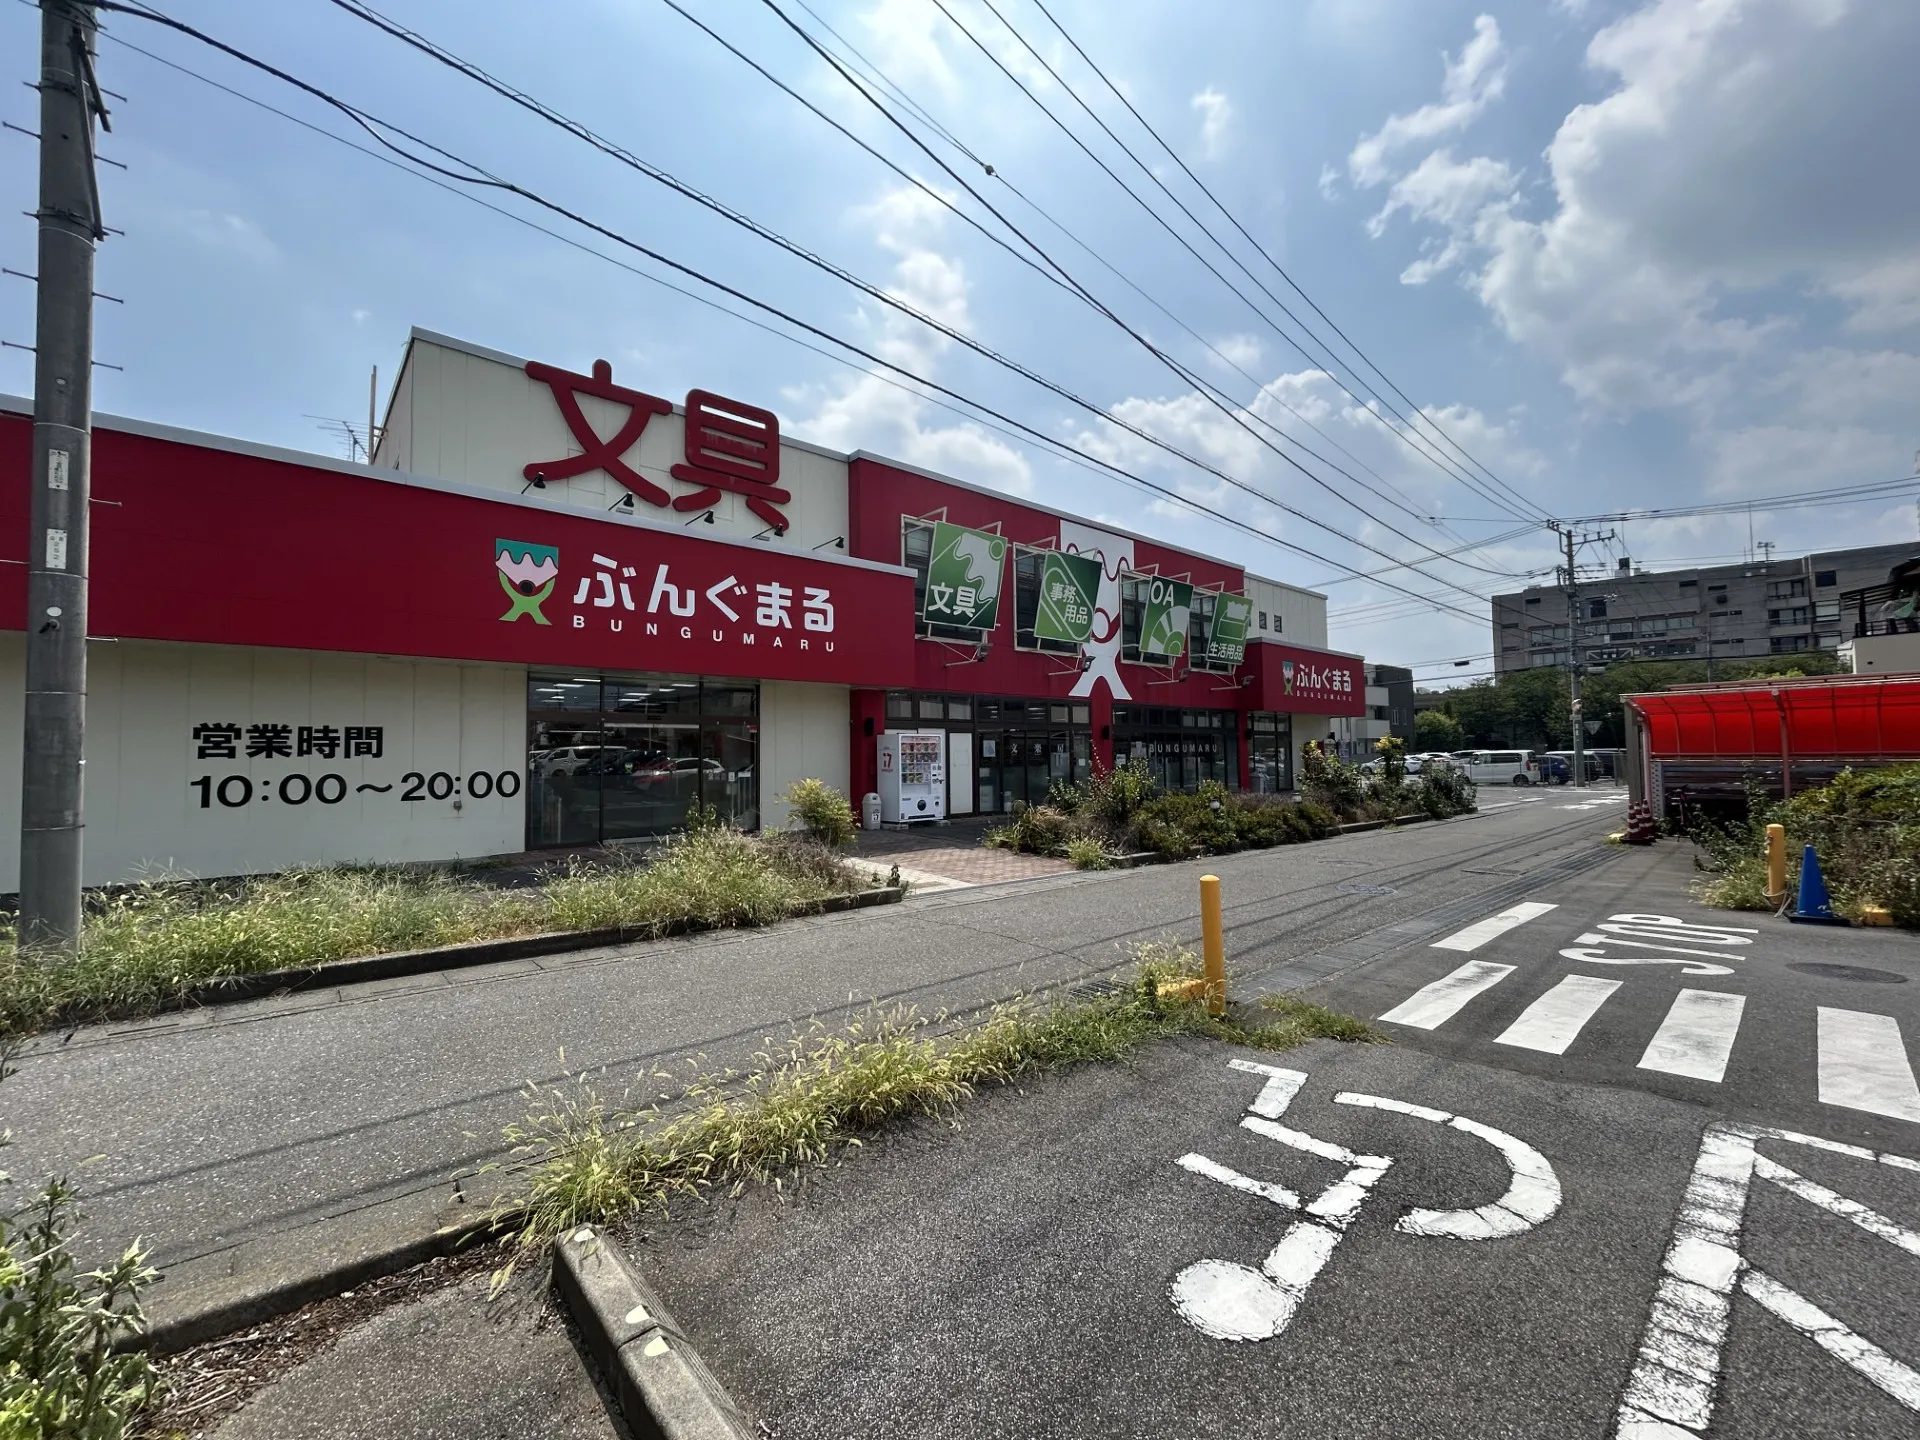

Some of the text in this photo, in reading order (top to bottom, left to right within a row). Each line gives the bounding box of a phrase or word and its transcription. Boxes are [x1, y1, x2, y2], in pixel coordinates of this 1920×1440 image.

[523, 358, 791, 531] 文具
[573, 553, 834, 633] ぶんぐまる
[927, 582, 976, 618] 文具
[1050, 582, 1076, 603] 事務
[1150, 580, 1174, 607] OA
[1063, 604, 1088, 625] 用品
[573, 615, 835, 652] BUNGUMARU
[1208, 641, 1243, 660] 生活用品
[1296, 663, 1352, 692] ぶんぐまる
[192, 722, 385, 760] 営業時間
[1149, 743, 1218, 753] BUNGUMARU
[1559, 913, 1759, 975] STOP
